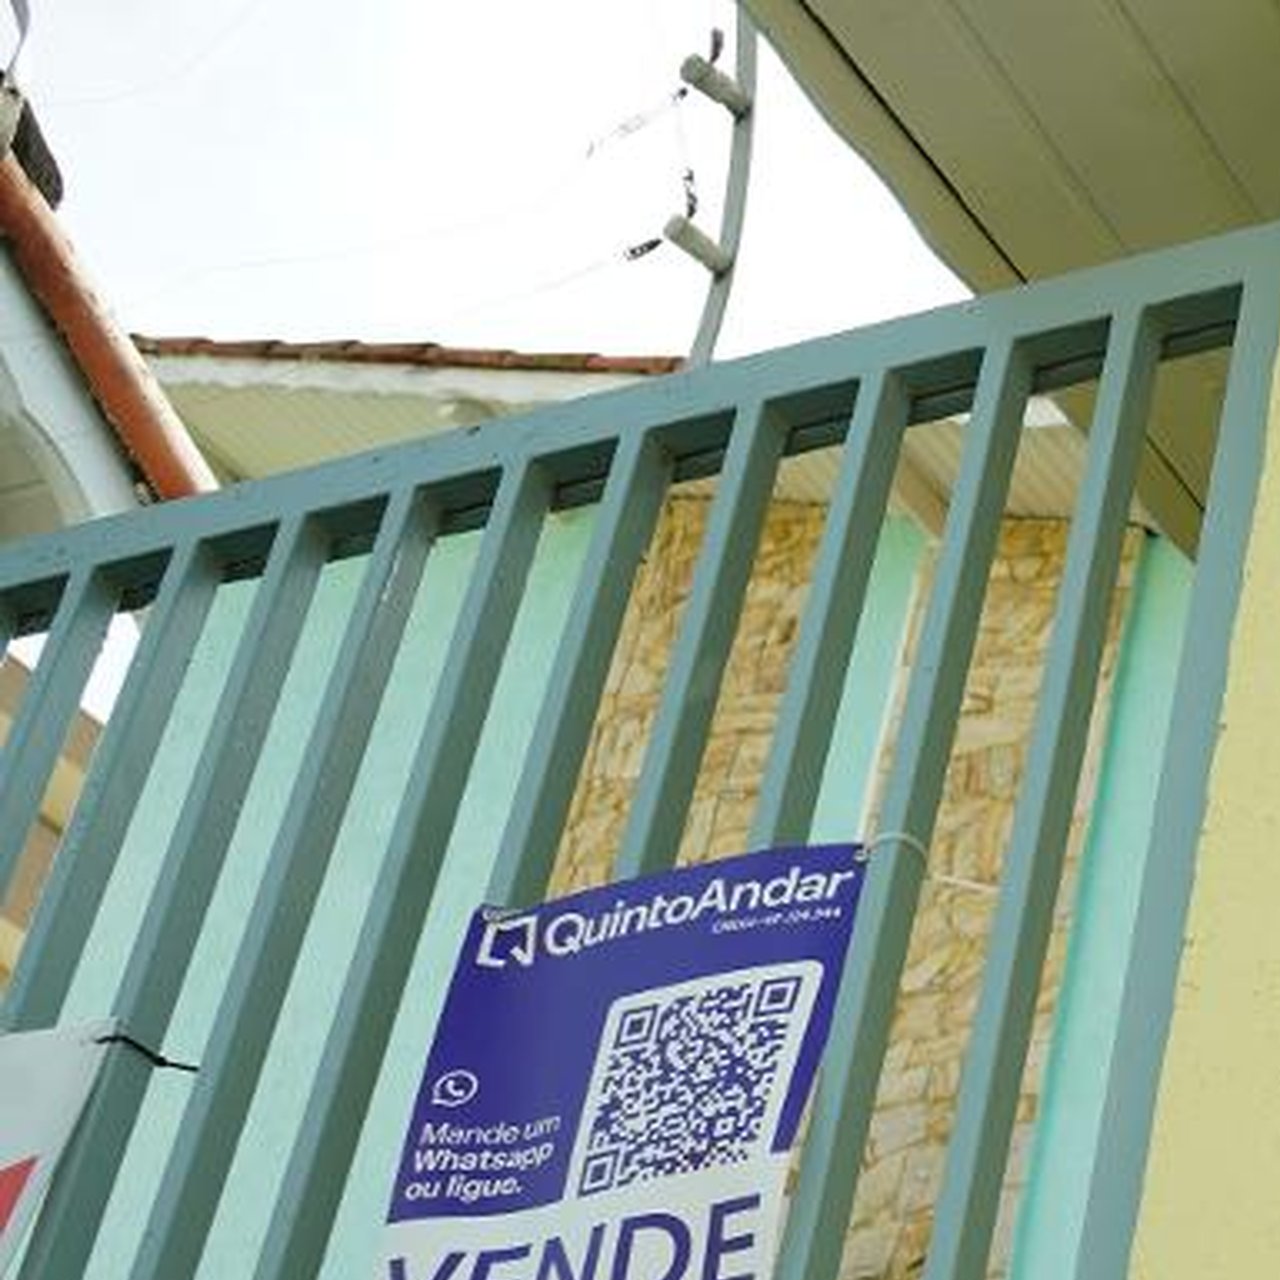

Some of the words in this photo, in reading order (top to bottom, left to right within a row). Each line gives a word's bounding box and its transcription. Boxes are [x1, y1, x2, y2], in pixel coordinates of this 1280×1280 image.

[543, 866, 854, 956] QuintoAndar
[419, 1121, 520, 1146] Mande
[523, 1115, 561, 1141] um
[414, 1141, 554, 1173] Whatsapp
[404, 1180, 441, 1201] ou
[445, 1173, 524, 1204] ligue.
